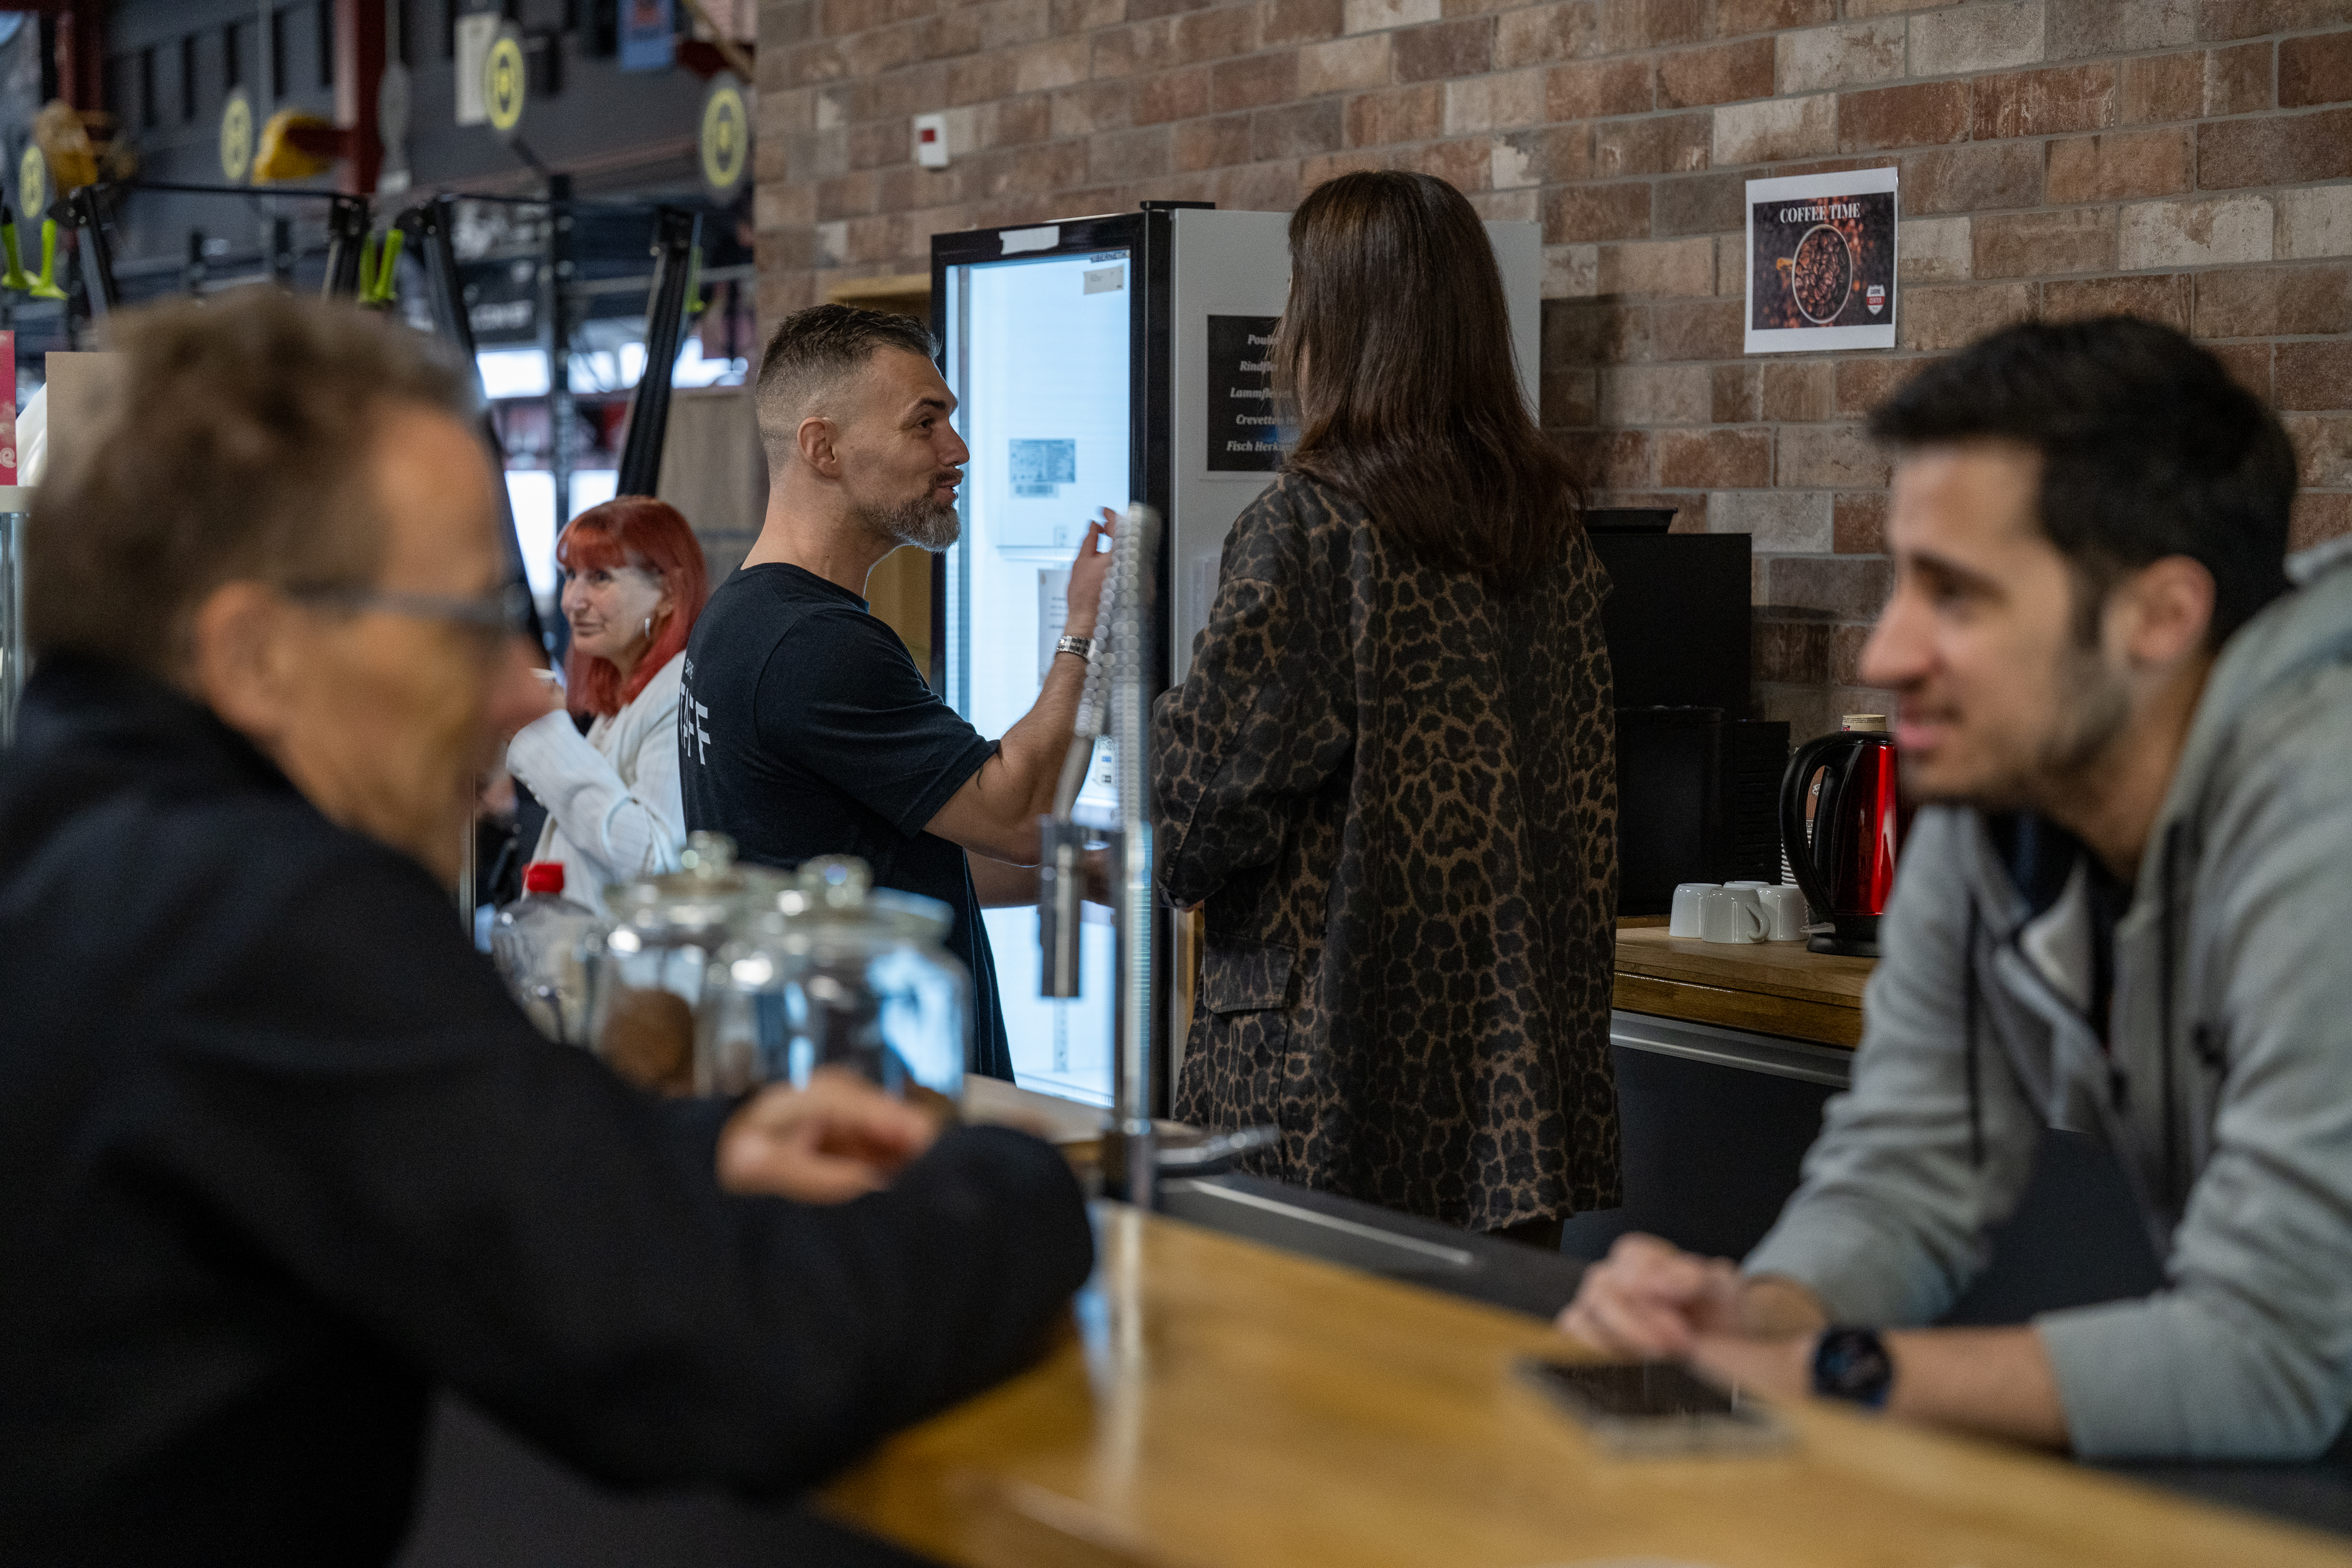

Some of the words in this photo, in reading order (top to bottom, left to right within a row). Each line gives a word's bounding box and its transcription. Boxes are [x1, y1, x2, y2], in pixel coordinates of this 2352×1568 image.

[1780, 206, 1826, 223] COFFEE
[1829, 202, 1860, 220] TIME
[1226, 440, 1254, 452] Fisch
